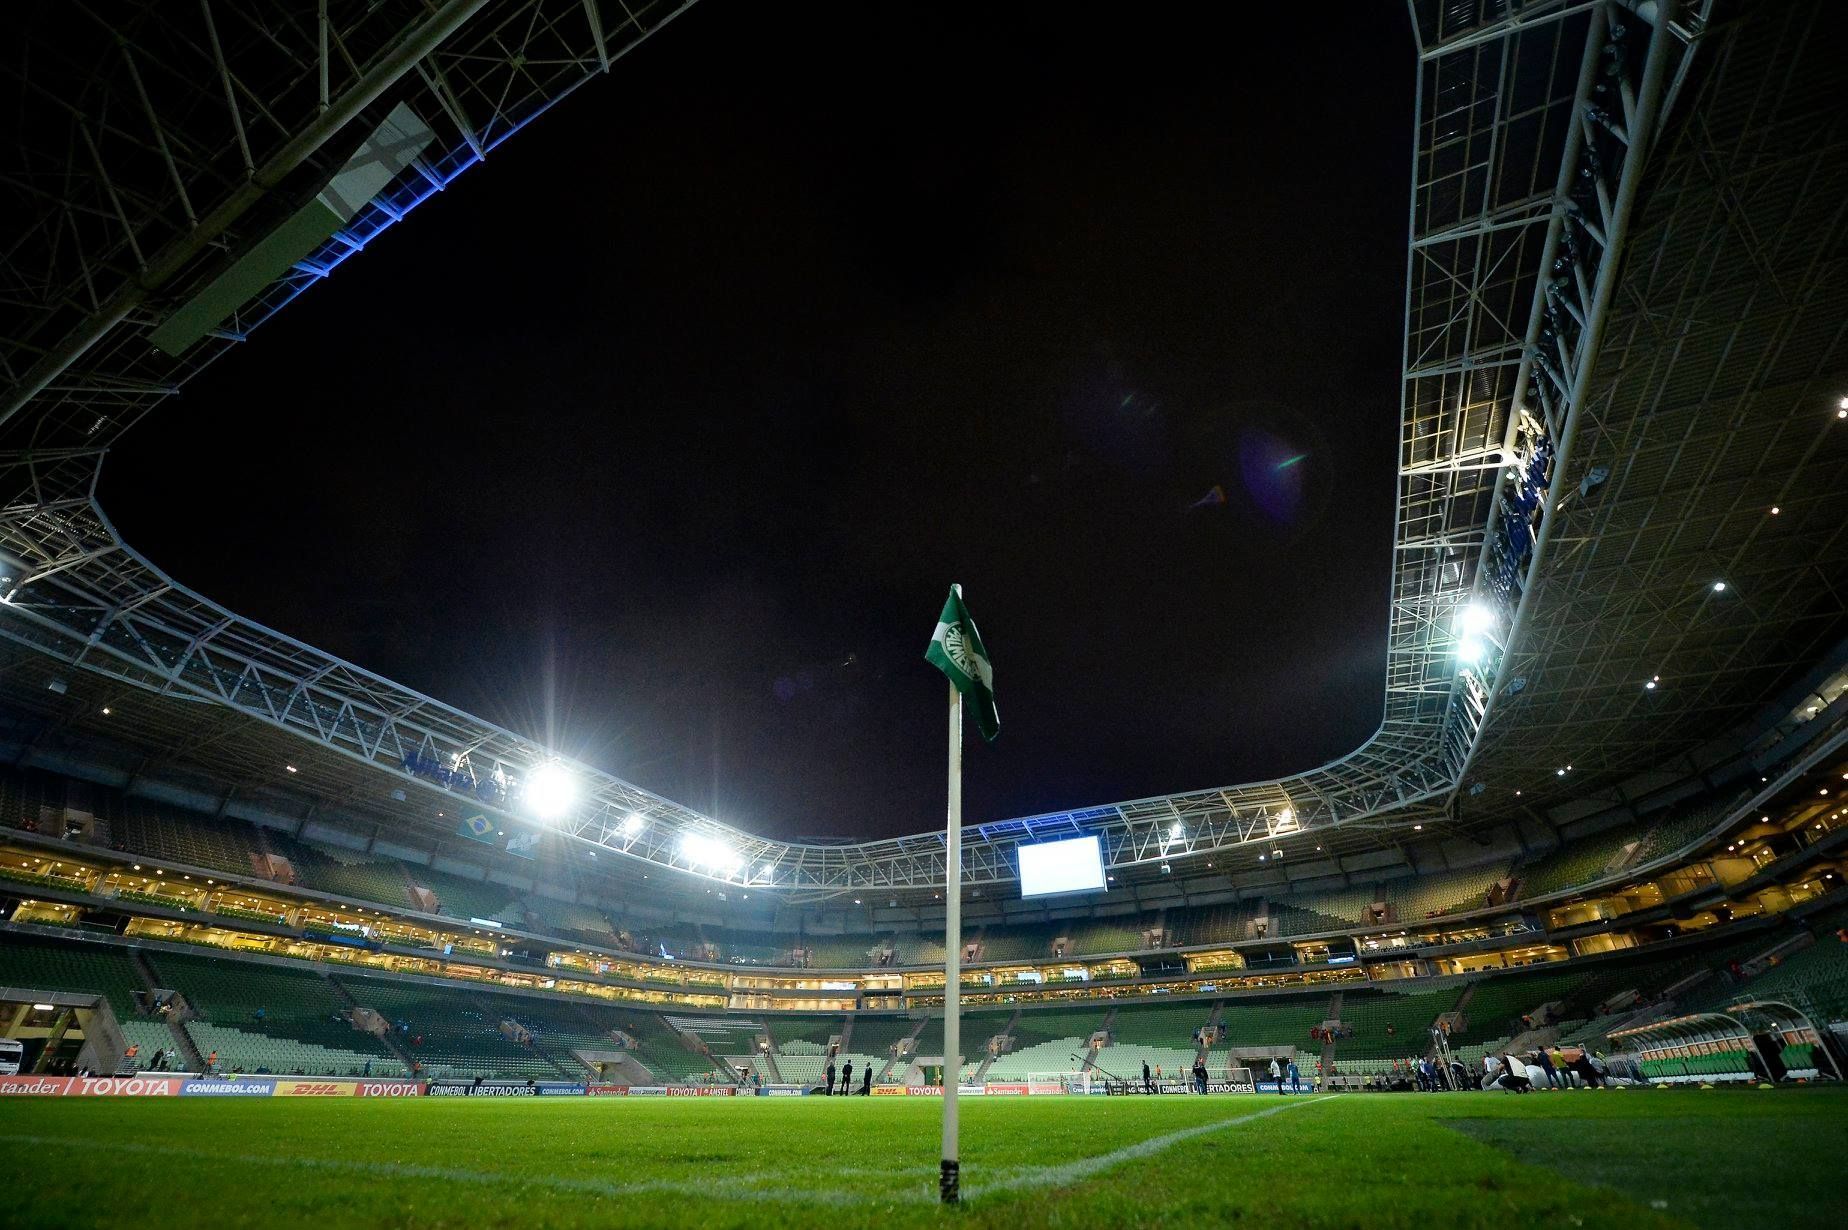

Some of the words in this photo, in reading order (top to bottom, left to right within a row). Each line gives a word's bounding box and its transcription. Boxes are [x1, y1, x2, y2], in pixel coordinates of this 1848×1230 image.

[81, 1078, 169, 1095] TOYOTA
[186, 1083, 270, 1094] CONMEBOL.COM
[291, 1084, 338, 1095] DHL
[362, 1083, 418, 1096] TOYOTA
[429, 1085, 466, 1096] CONMEBOL
[468, 1085, 536, 1096] LIBERTADORES
[596, 1087, 626, 1096] Santander
[670, 1088, 698, 1096] TOYOTA
[909, 1087, 941, 1096] TOYOTA
[993, 1087, 1024, 1095] Santander
